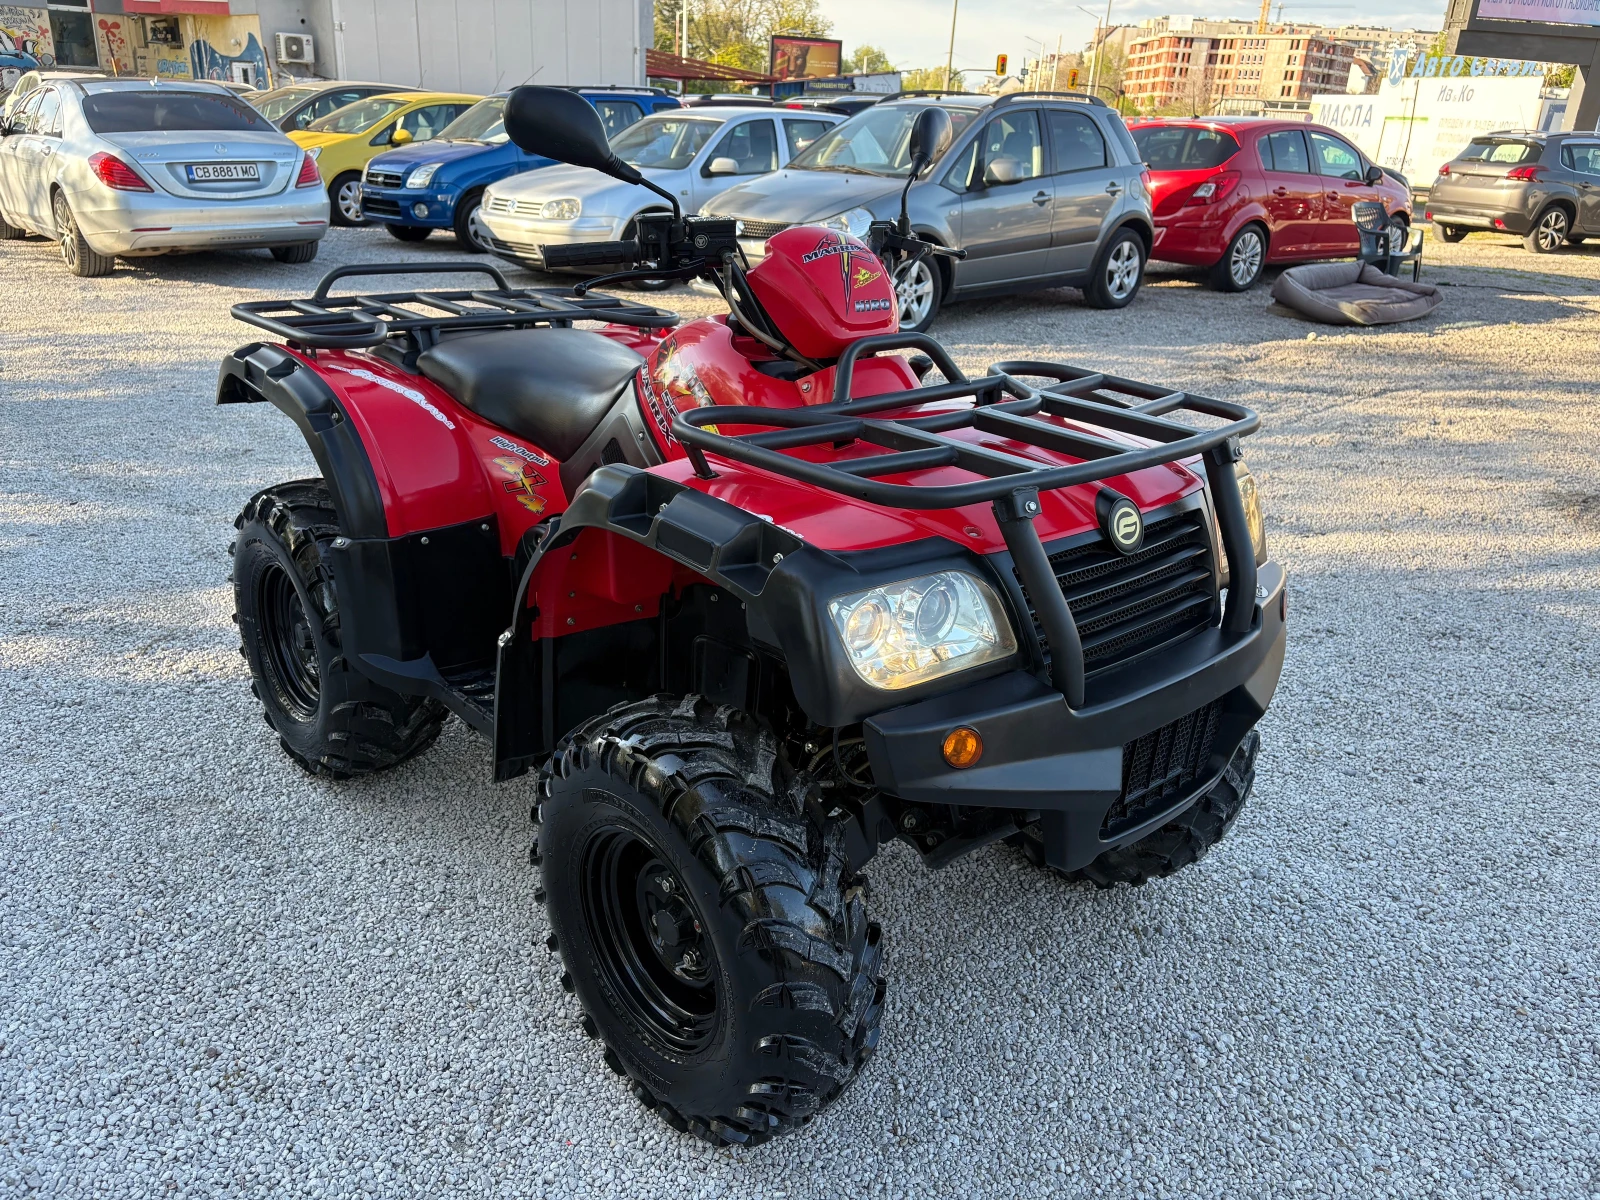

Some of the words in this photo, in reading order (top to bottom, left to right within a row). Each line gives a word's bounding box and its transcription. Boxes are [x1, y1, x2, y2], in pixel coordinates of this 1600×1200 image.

[1319, 104, 1373, 127] МАСЛА
[195, 166, 211, 178] CB
[212, 165, 239, 178] 8881
[240, 165, 257, 177] MO
[802, 244, 866, 264] MATRIX
